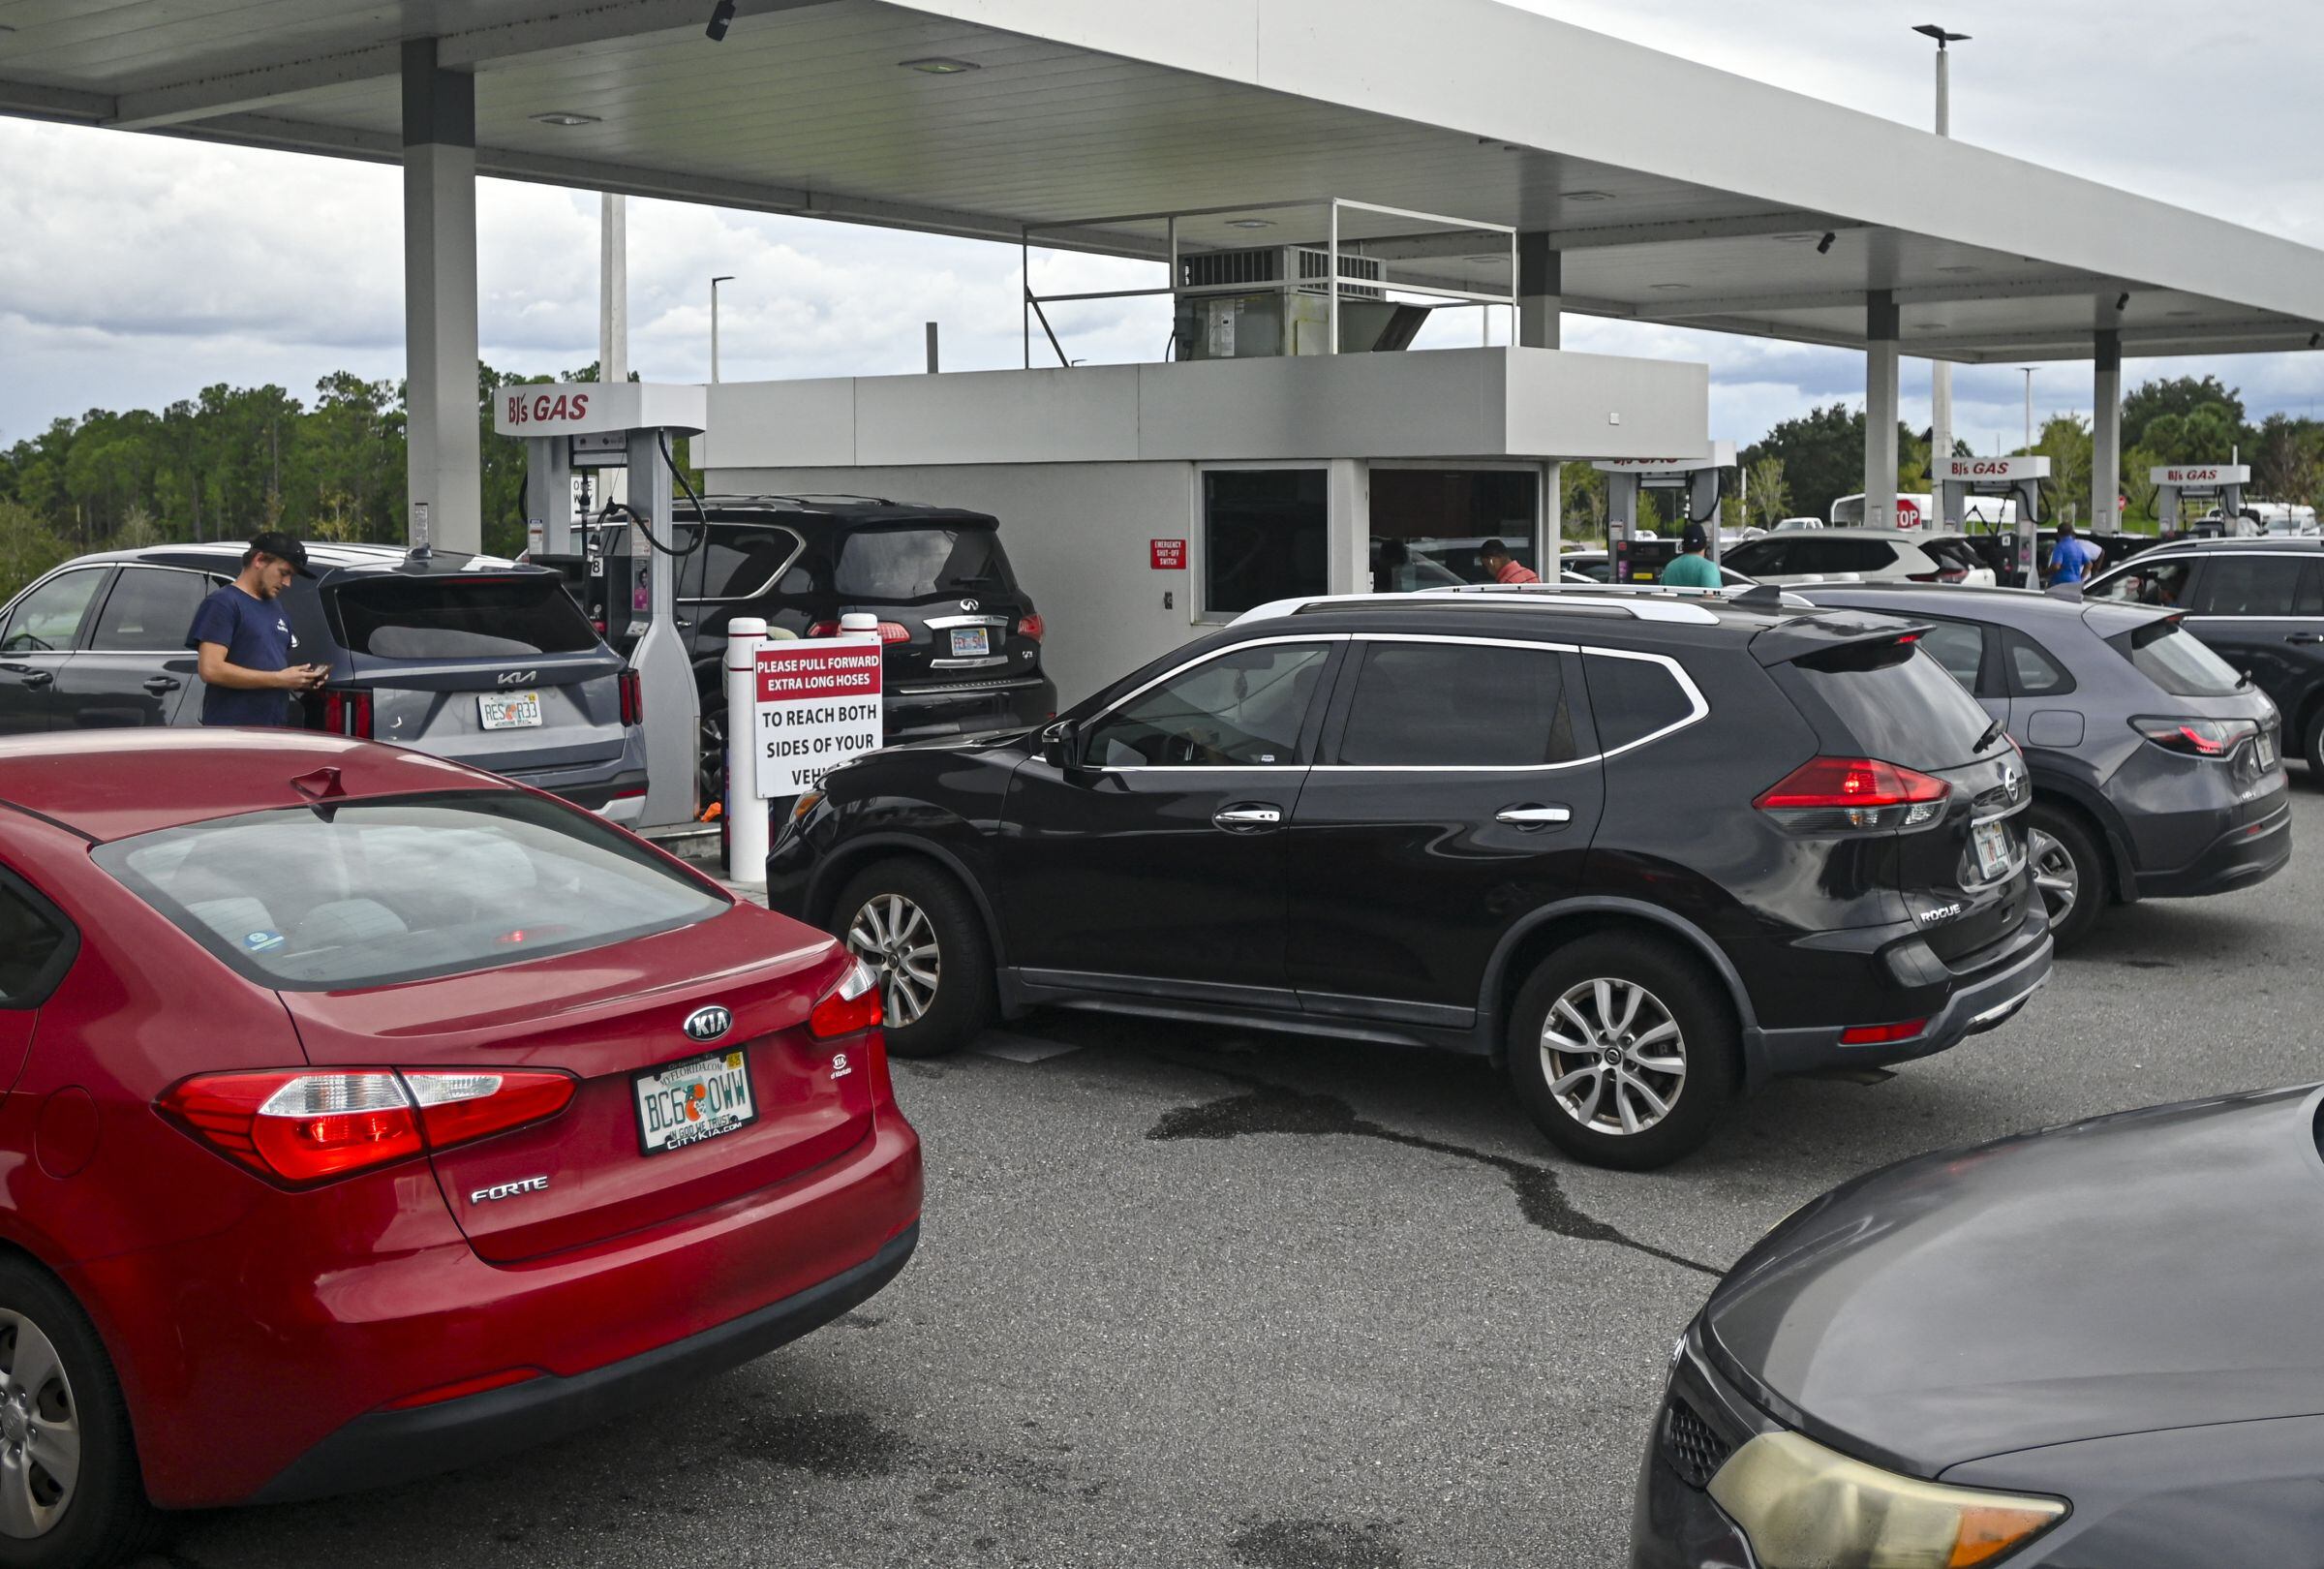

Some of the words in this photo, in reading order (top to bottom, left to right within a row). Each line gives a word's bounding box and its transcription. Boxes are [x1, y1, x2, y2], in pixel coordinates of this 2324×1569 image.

[534, 394, 589, 421] GAS
[1972, 461, 2009, 475] GAS
[2186, 469, 2217, 480] GAS
[573, 480, 592, 491] OE
[1896, 510, 1918, 526] OP
[592, 561, 600, 573] 8
[757, 660, 797, 674] PLEASE
[800, 658, 826, 671] PULL
[828, 655, 879, 669] FORWARD
[768, 678, 803, 692] EXTRA
[805, 676, 834, 689] LONG
[836, 673, 870, 687] HOSES
[762, 711, 782, 728] TO
[786, 707, 835, 726] REACH
[839, 704, 877, 722] BOTH
[767, 739, 810, 758] SIDES
[813, 737, 832, 754] OF
[835, 733, 874, 751] YOUR
[792, 768, 826, 785] VEH
[1920, 903, 1962, 923] ROGUE
[694, 1015, 727, 1036] KIA
[679, 1124, 694, 1138] GOD
[695, 1121, 706, 1132] WE
[707, 1114, 731, 1129] TRUST
[471, 1176, 549, 1204] FORTE
